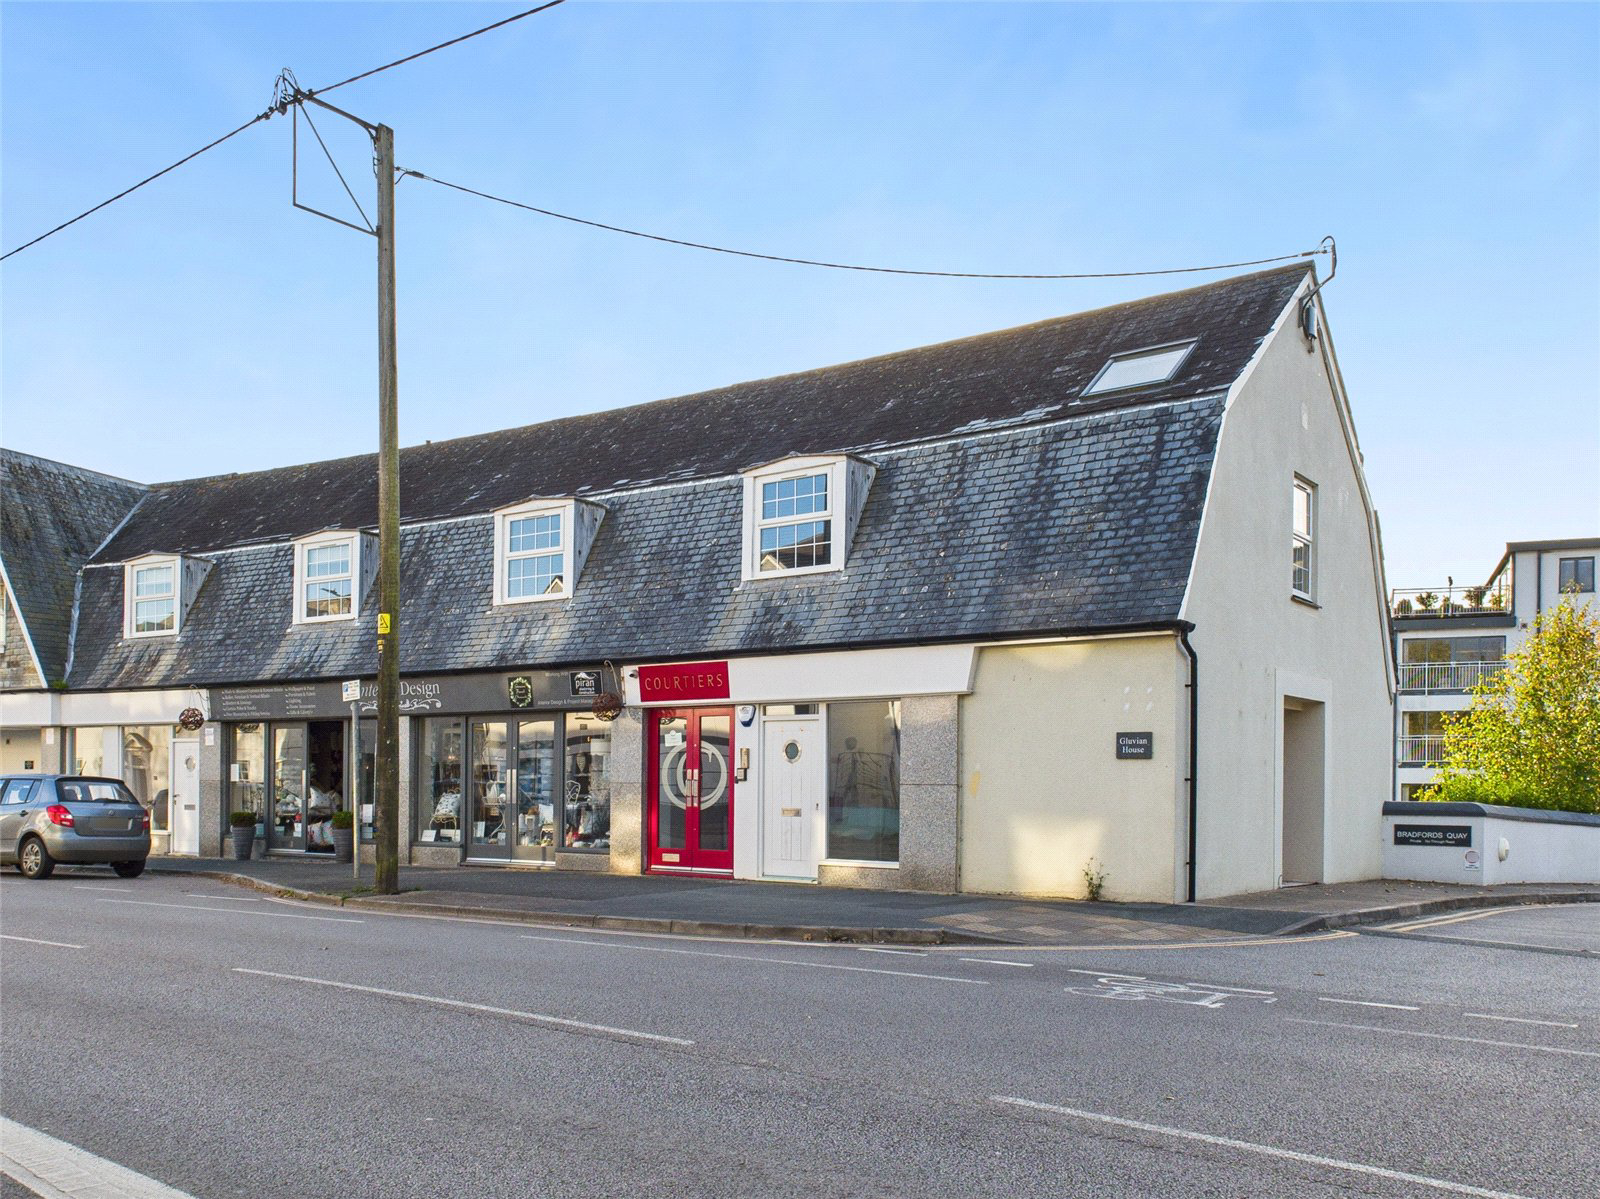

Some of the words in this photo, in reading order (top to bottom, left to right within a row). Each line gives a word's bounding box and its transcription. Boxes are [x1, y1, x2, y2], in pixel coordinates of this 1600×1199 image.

[575, 678, 595, 690] piran
[645, 674, 723, 691] COURTIERS
[400, 681, 440, 698] Design
[1119, 737, 1148, 745] Gluvian
[1397, 831, 1443, 839] BRADFORDS
